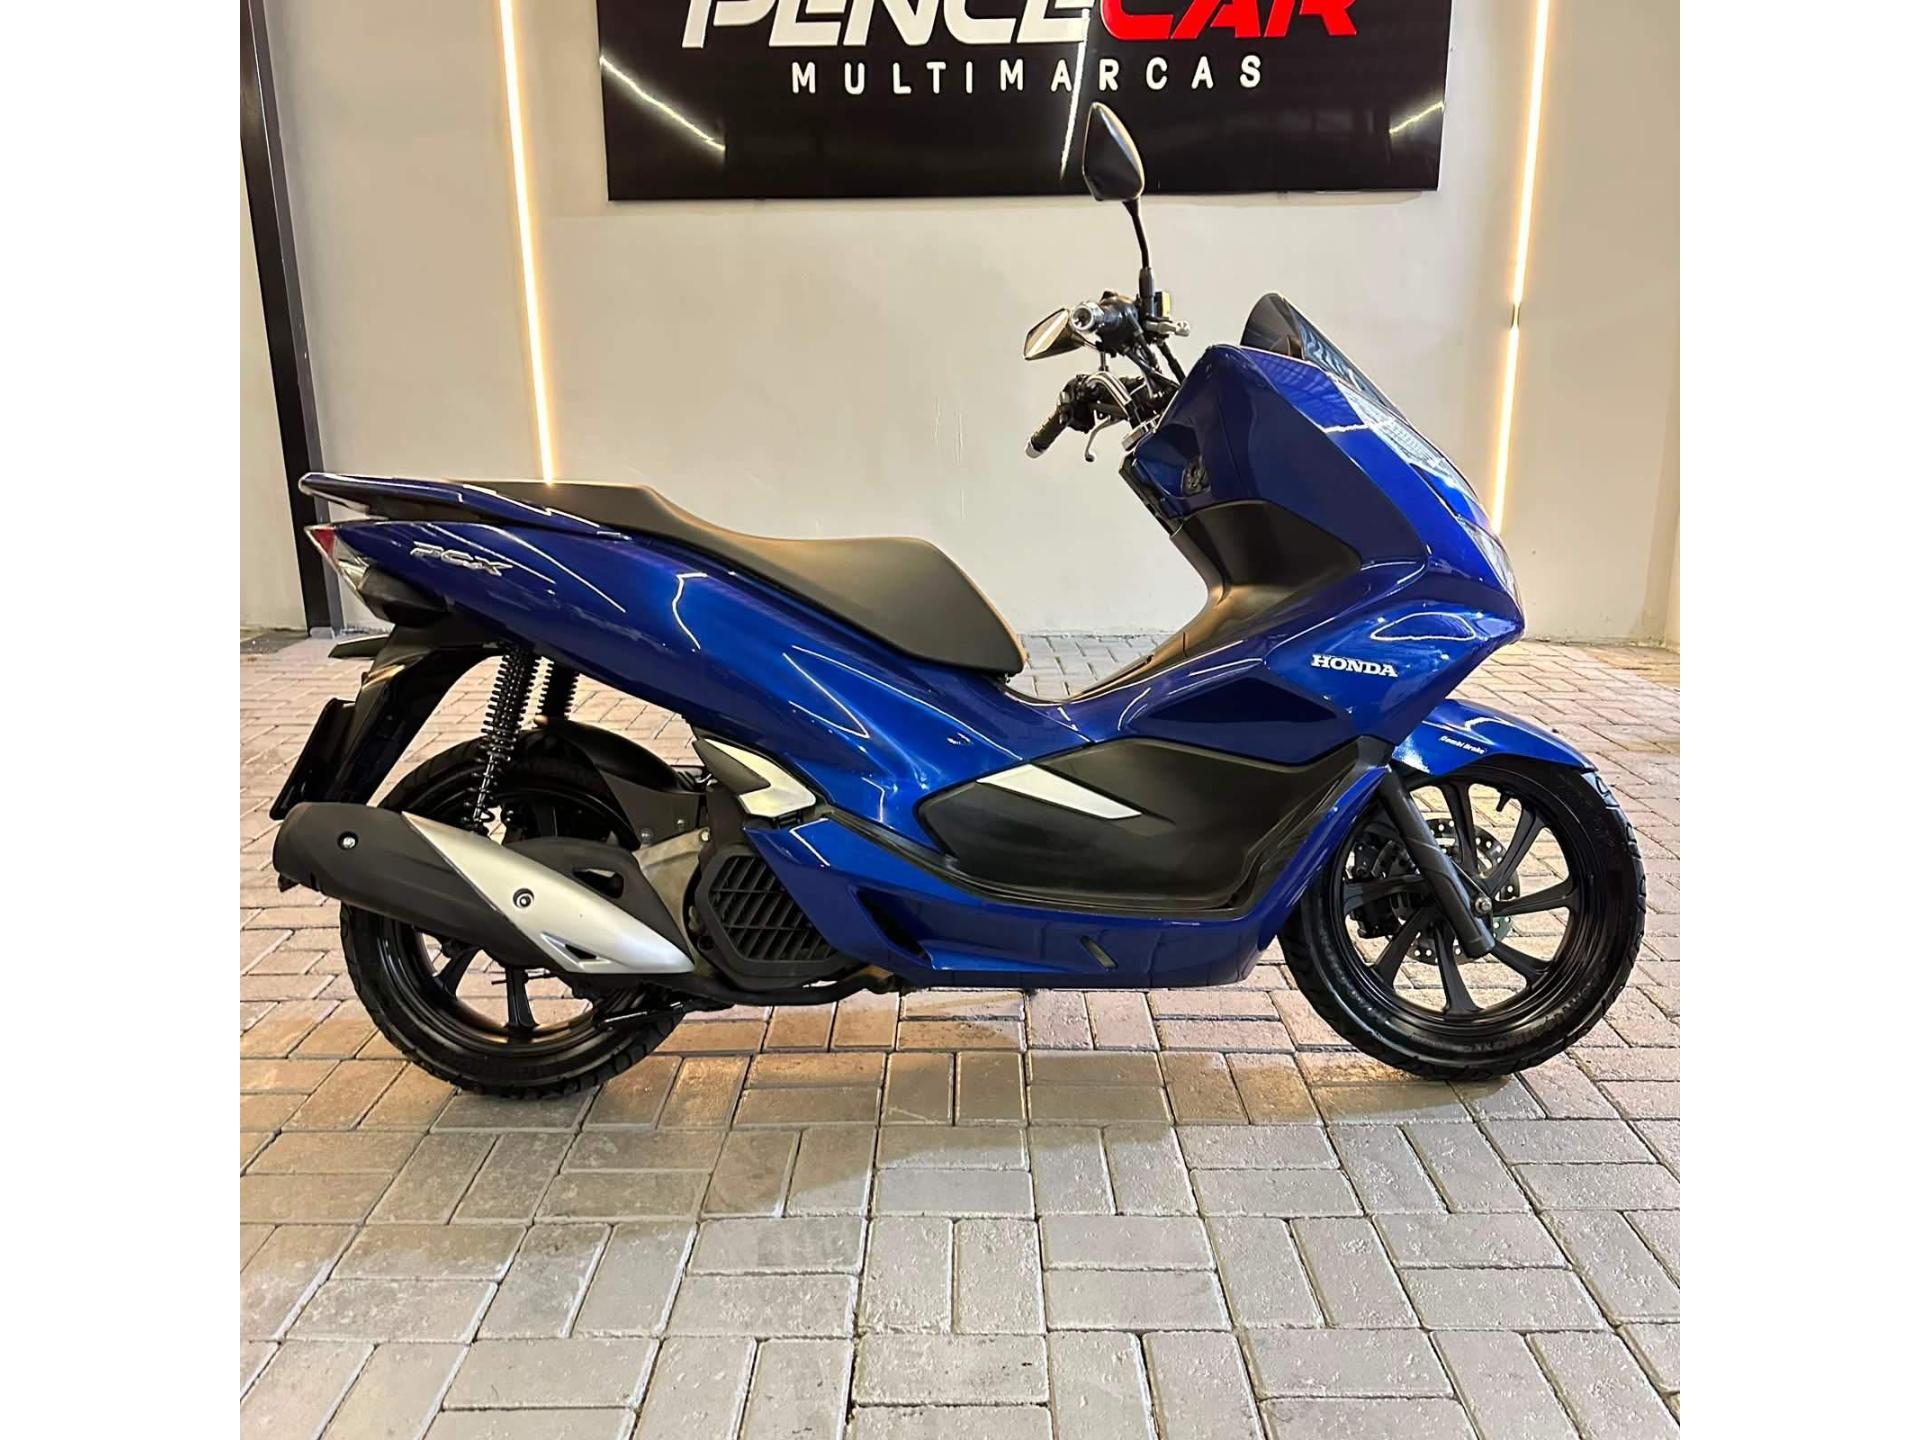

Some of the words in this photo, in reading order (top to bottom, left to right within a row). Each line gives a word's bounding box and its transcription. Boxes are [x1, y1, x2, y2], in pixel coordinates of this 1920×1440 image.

[791, 55, 1262, 95] MULTIMARCAS
[410, 541, 513, 576] PCX
[1311, 654, 1398, 677] HONDA
[1439, 735, 1464, 748] Combi
